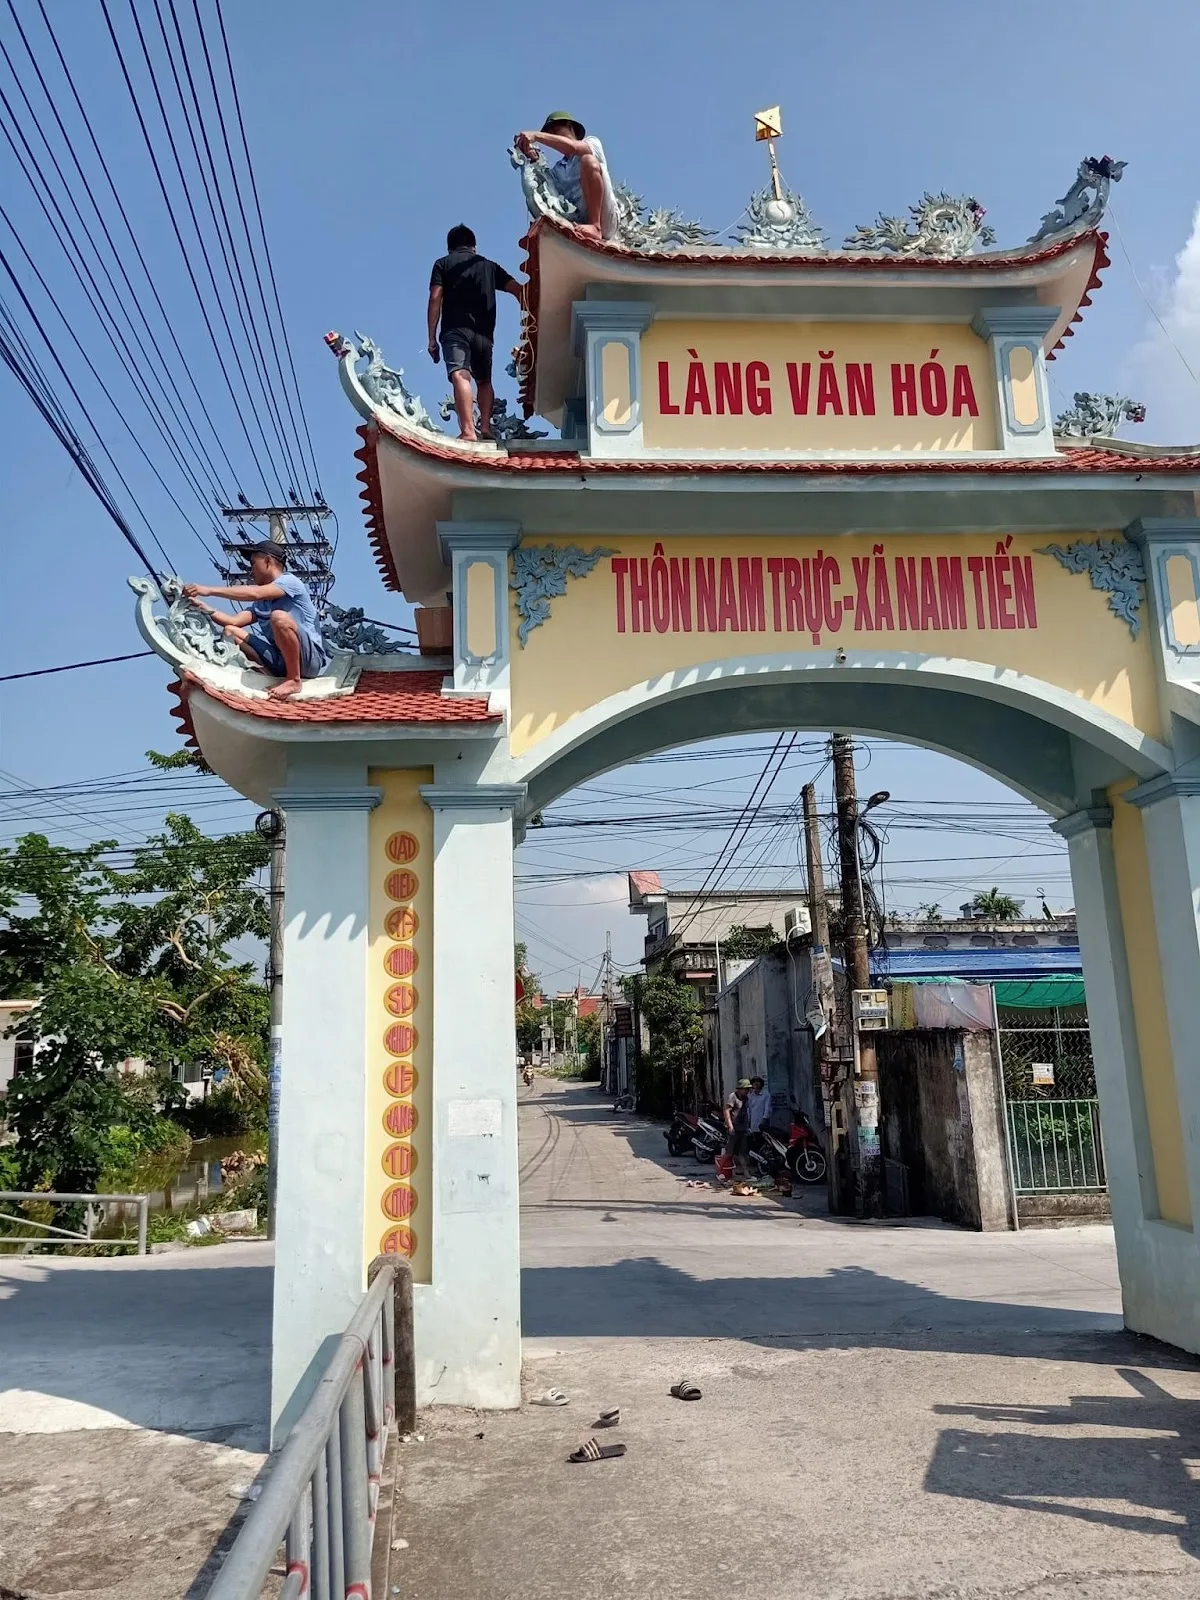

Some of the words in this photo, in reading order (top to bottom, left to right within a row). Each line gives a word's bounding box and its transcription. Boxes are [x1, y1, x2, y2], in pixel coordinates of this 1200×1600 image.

[658, 348, 773, 416] LÀNG
[786, 350, 876, 416] VĂN
[890, 348, 980, 417] HÓA
[611, 542, 690, 633] THÔN
[697, 556, 766, 632] NAM
[899, 556, 967, 631] NAM
[967, 534, 1038, 630] TIẾN
